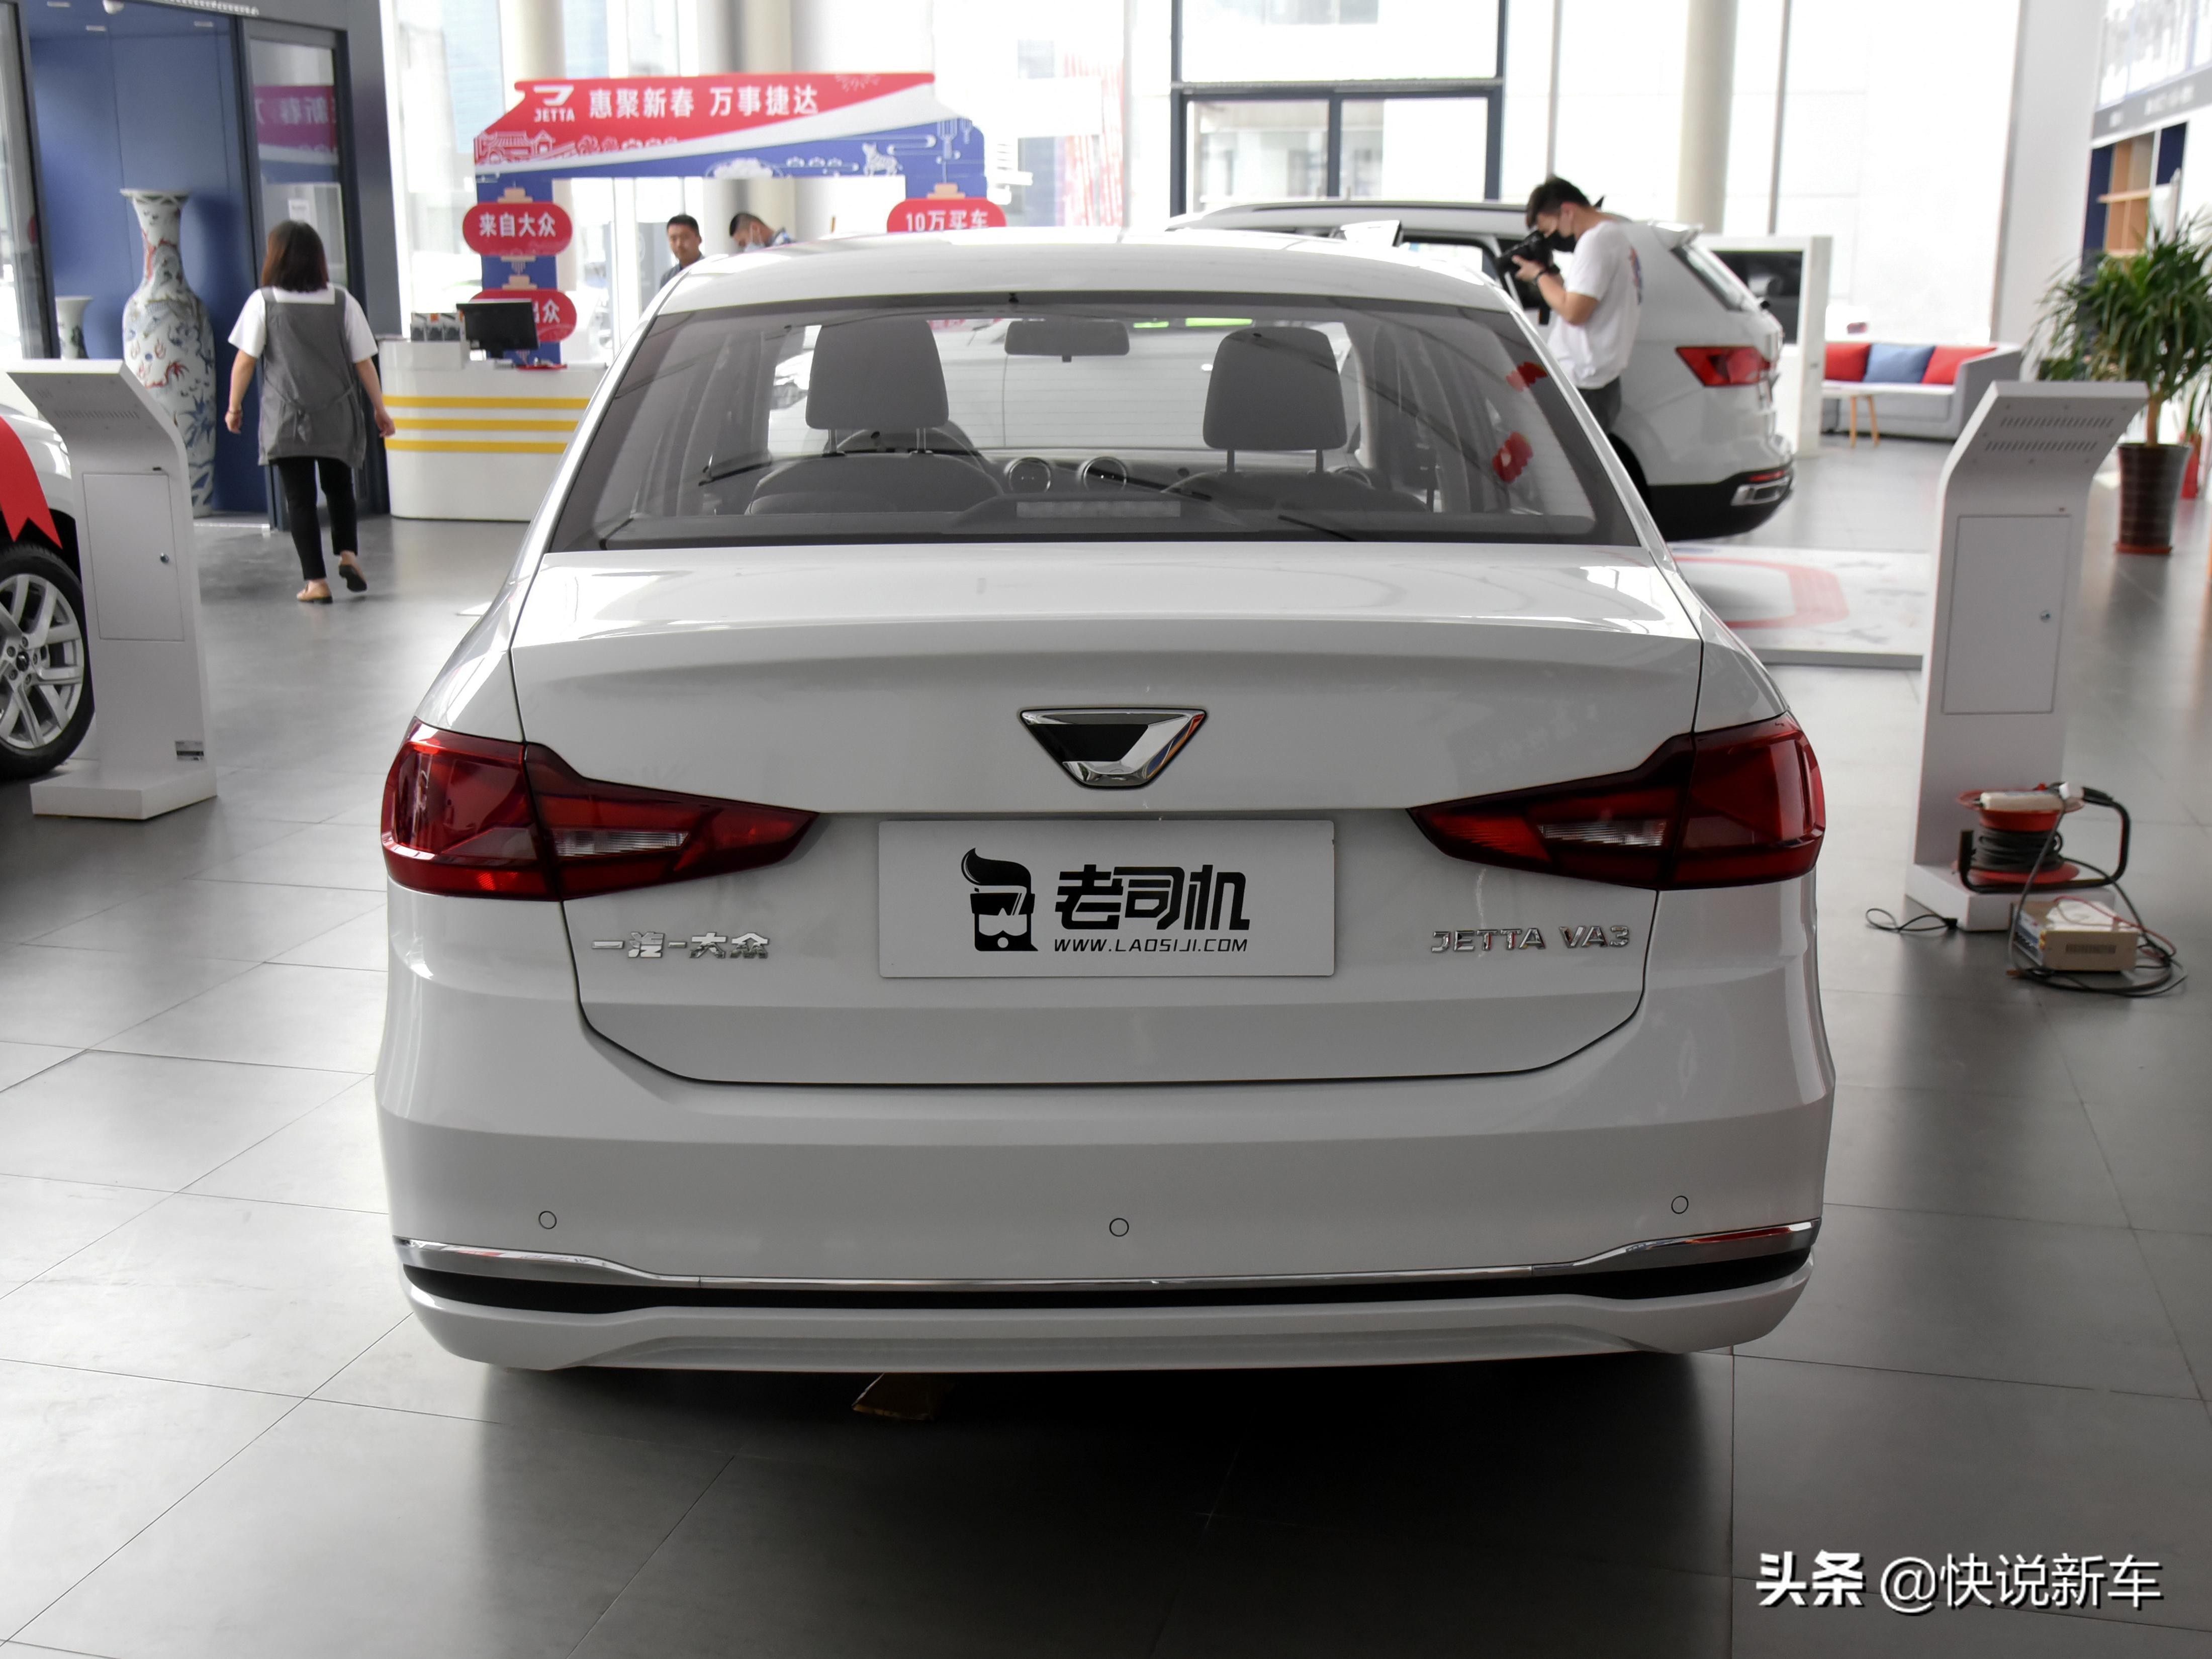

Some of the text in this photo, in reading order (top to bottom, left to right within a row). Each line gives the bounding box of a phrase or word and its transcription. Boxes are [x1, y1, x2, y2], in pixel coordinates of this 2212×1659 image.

[589, 82, 818, 119] 惠聚新春 万事捷达
[534, 108, 575, 122] JETTA
[479, 212, 556, 238] 来自大众
[906, 208, 989, 233] 10万买车
[1055, 864, 1250, 931] 老司机
[1054, 939, 1248, 952] WWW.LAOSIJI.COM
[1431, 925, 1630, 953] JETTA VA3
